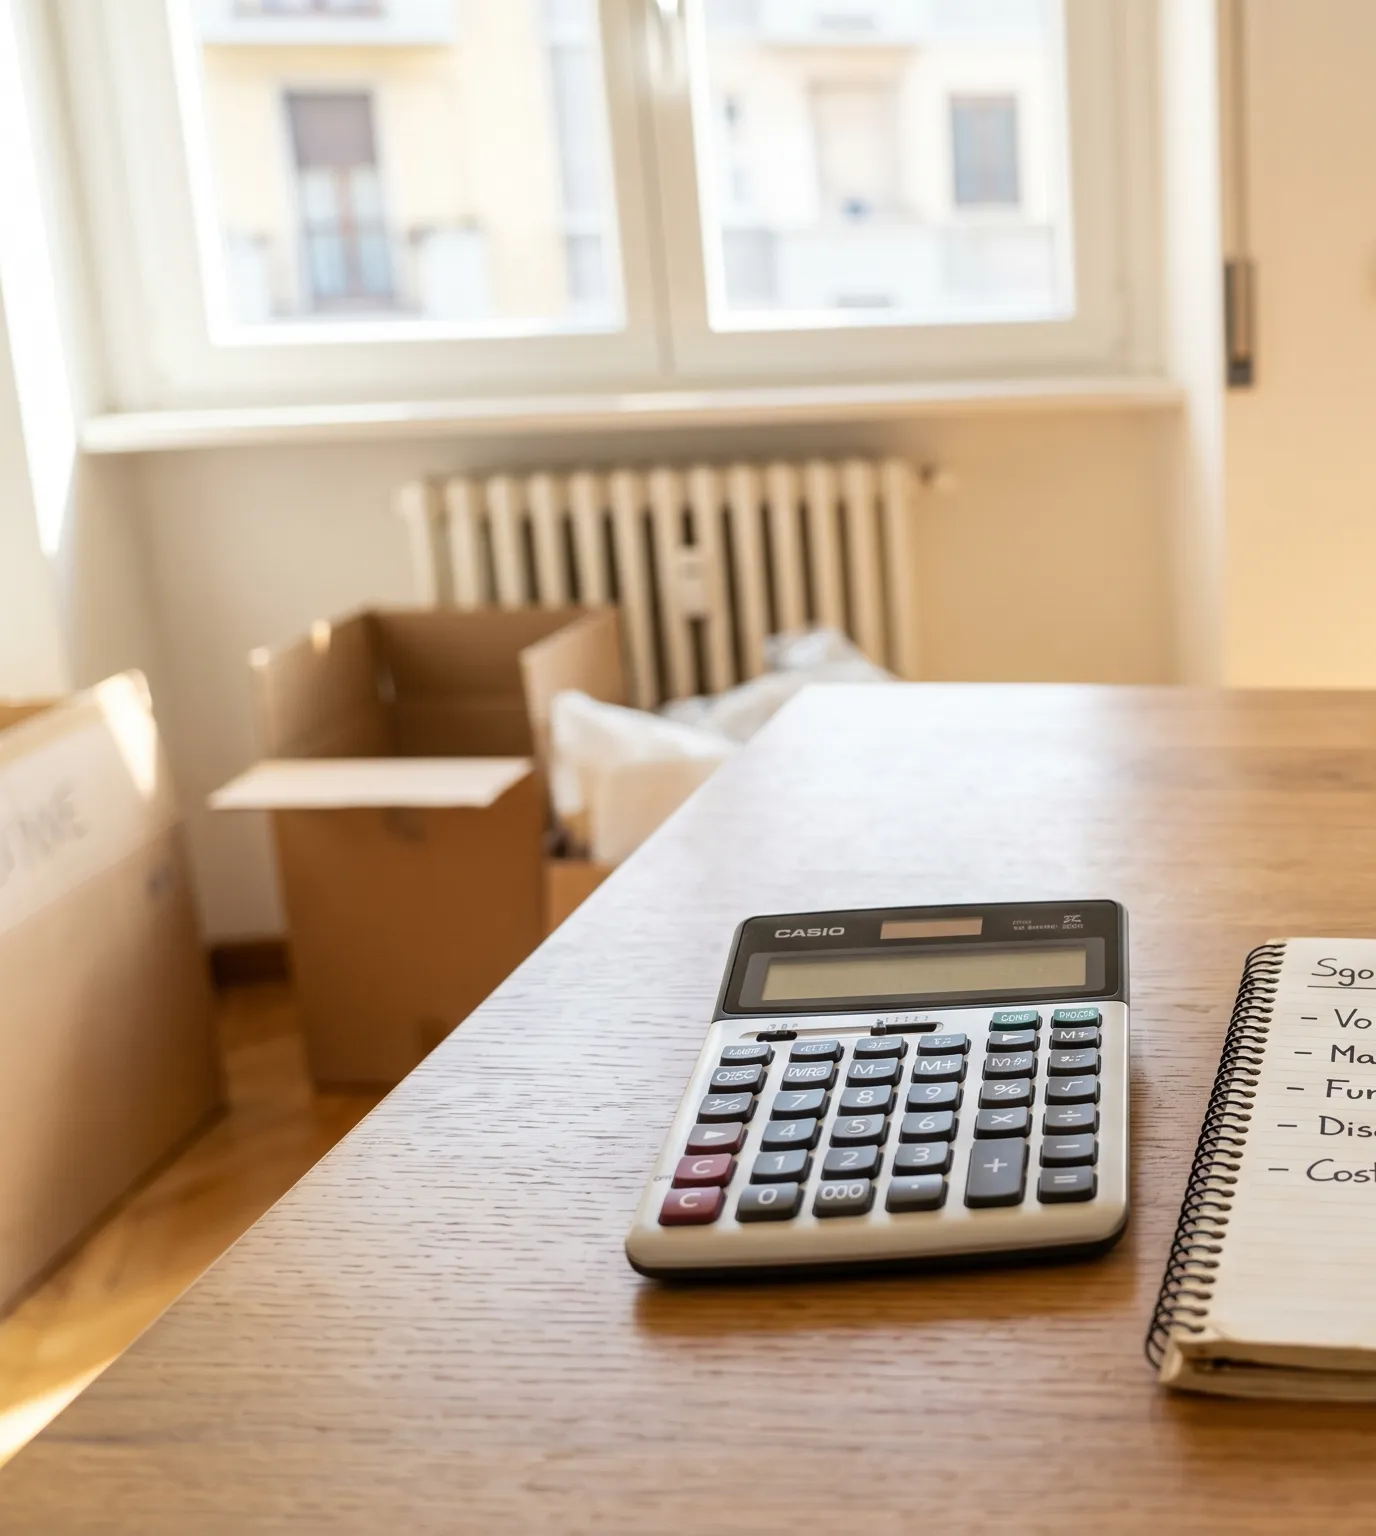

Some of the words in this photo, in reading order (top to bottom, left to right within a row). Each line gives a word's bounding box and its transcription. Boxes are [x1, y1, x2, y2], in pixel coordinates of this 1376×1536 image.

[774, 926, 846, 939] CASIO
[920, 1060, 957, 1071] M+
[856, 1090, 874, 1104] 8
[925, 1086, 942, 1100] 9
[791, 1095, 808, 1108] 7
[851, 1119, 866, 1132] 5
[918, 1115, 936, 1130] 6
[778, 1123, 796, 1138] 4
[775, 1155, 785, 1170] 1
[839, 1151, 859, 1167] 2
[912, 1147, 930, 1163] 3
[691, 1159, 714, 1175] C
[983, 1157, 1008, 1173] +
[679, 1191, 701, 1208] C
[757, 1188, 778, 1205] 0
